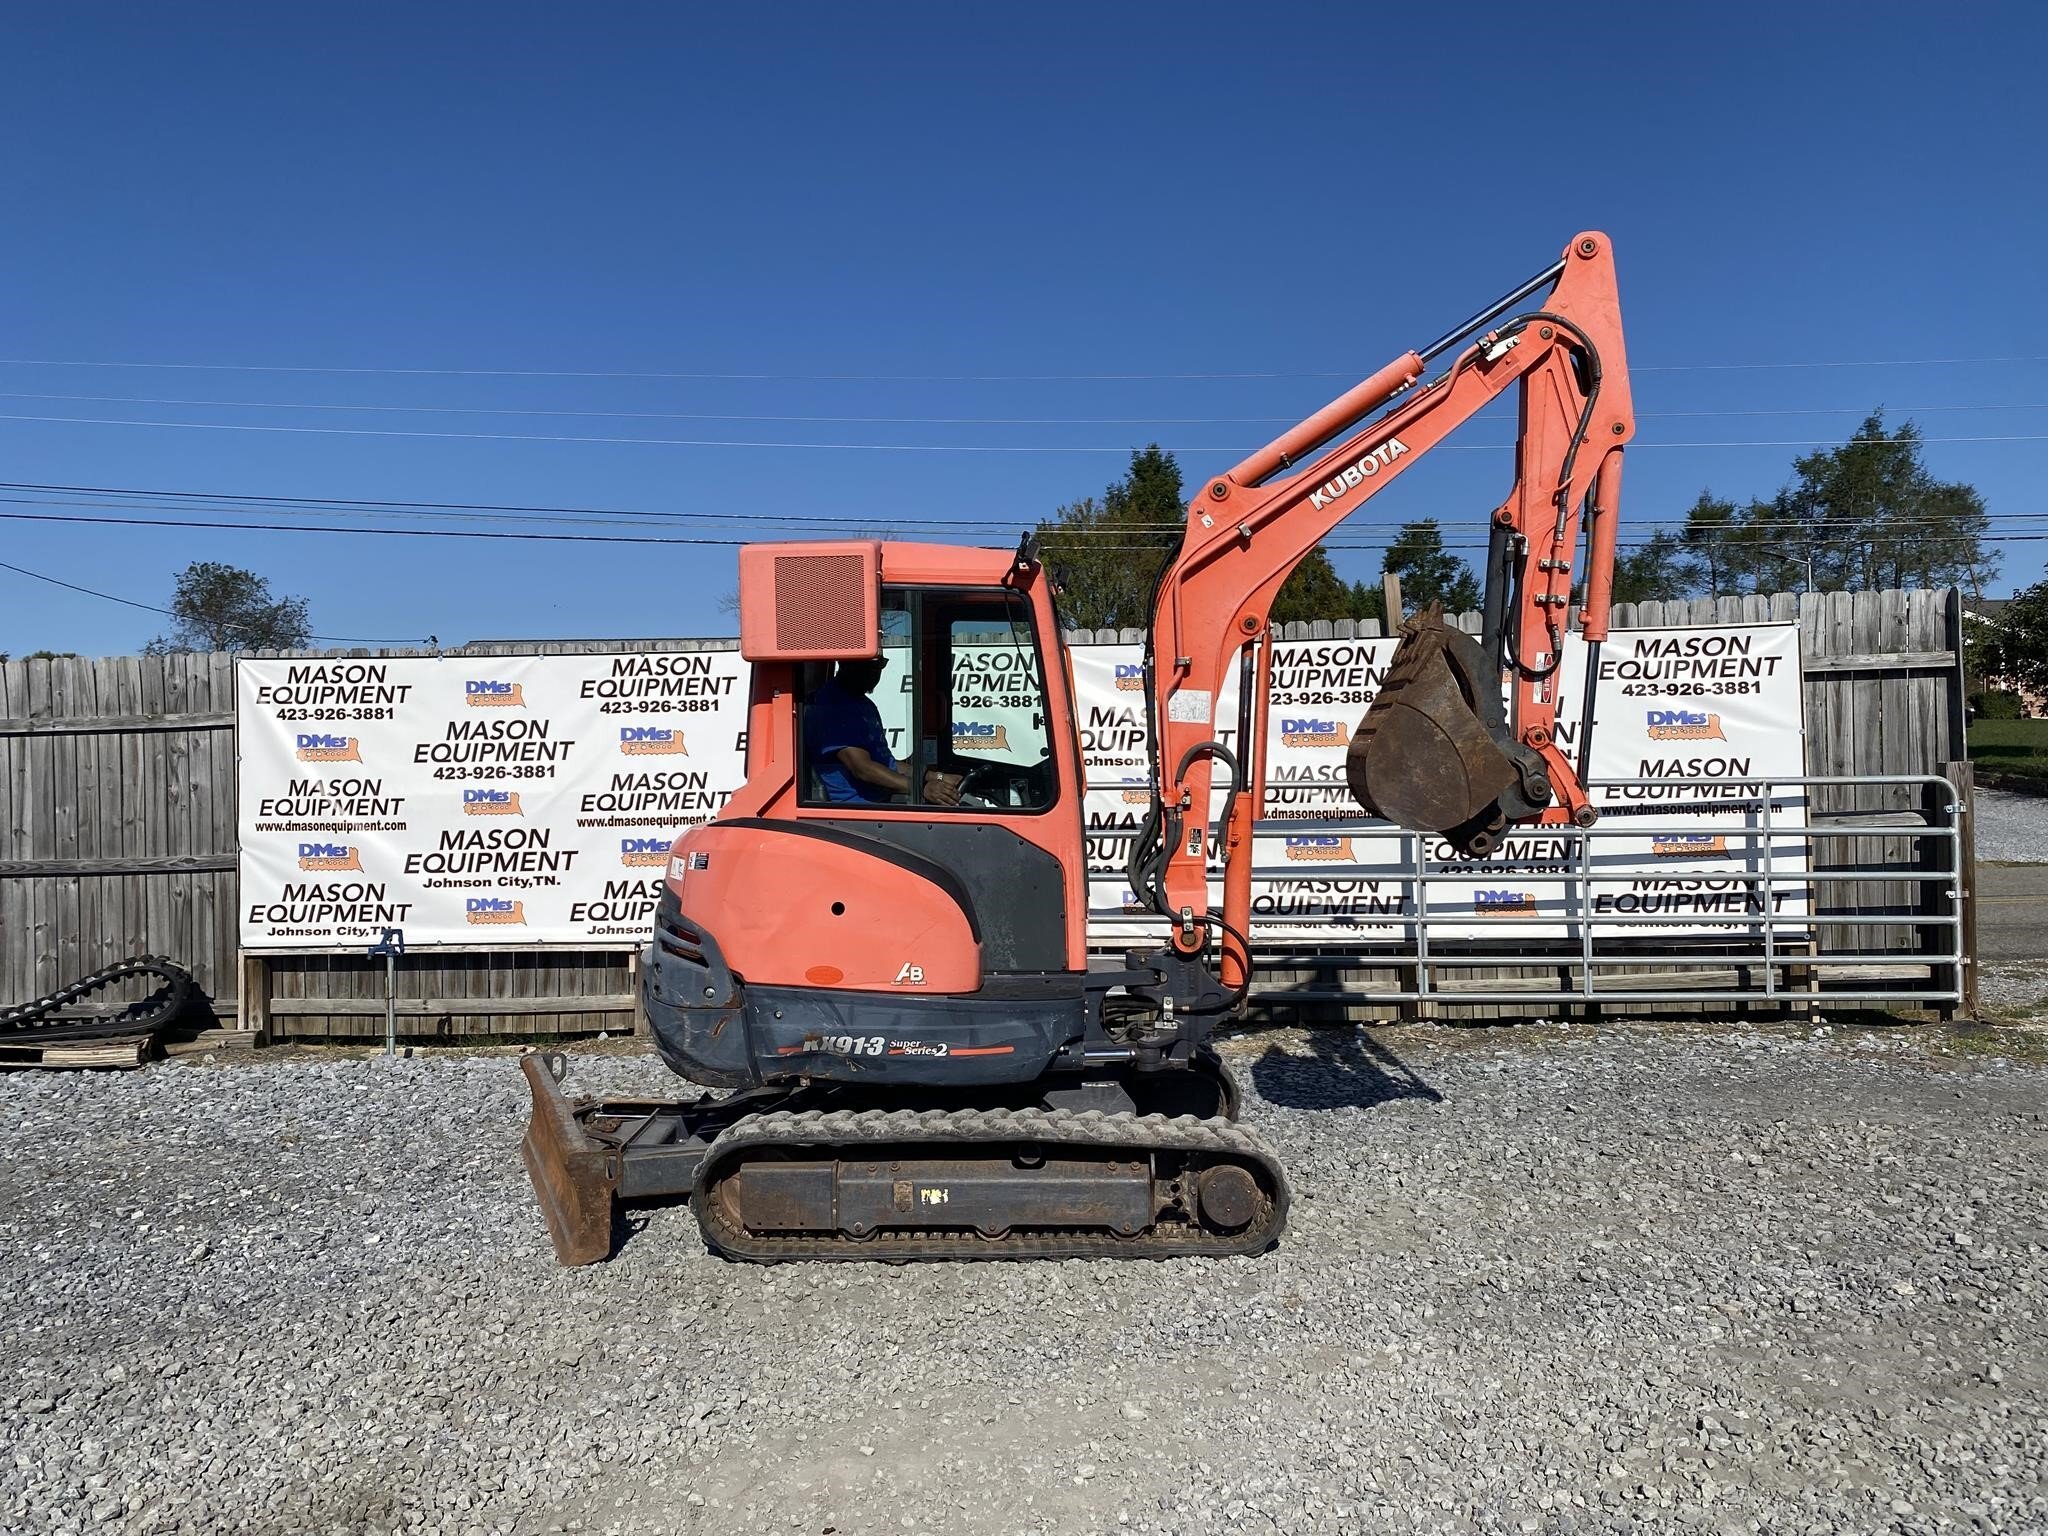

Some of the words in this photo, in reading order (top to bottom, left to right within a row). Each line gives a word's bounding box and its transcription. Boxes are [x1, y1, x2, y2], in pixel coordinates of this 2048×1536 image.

[1309, 437, 1410, 511] KUBOTA
[1270, 645, 1377, 668] MASON
[1634, 636, 1752, 658] MASON
[611, 656, 712, 677] MASON
[952, 652, 1035, 671] ASON
[1598, 656, 1783, 681] EQUIPMENT
[287, 665, 387, 685] MASON
[256, 685, 412, 705] EQUIPMENT
[580, 676, 738, 699] EQUIPMENT
[1621, 681, 1762, 697] 423-926-3881
[600, 699, 720, 714] 423-926-3881
[1270, 690, 1375, 706] 23-926-388
[276, 707, 394, 721] 423-926-3881
[446, 719, 550, 741] MASON
[413, 740, 576, 763] EQUIPMENT
[1084, 755, 1145, 767] ohnson
[433, 765, 556, 780] 423-926-3881
[1638, 757, 1751, 778] MASON
[288, 778, 382, 797] MASON
[610, 771, 709, 792] MASON
[259, 797, 405, 817] EQUIPMENT
[580, 790, 732, 812] EQUIPMENT
[1601, 801, 1783, 817] www.dmasonequipment.cm
[255, 819, 407, 834] www.dmasonequipment.com
[439, 828, 551, 850] MASON
[404, 850, 579, 874] EQUIPMENT
[423, 877, 492, 889] Johnson
[497, 875, 561, 889] City,TN.
[603, 880, 664, 900] MAS
[282, 883, 386, 902] MASON
[570, 901, 656, 922] EQUIP
[1252, 895, 1411, 915] QUIPMENT
[1594, 892, 1791, 914] EQUIPMENT
[248, 904, 413, 923] EQUIPMENT
[267, 926, 331, 936] Johnson
[586, 926, 653, 935] Johnson
[889, 1039, 922, 1050] Super
